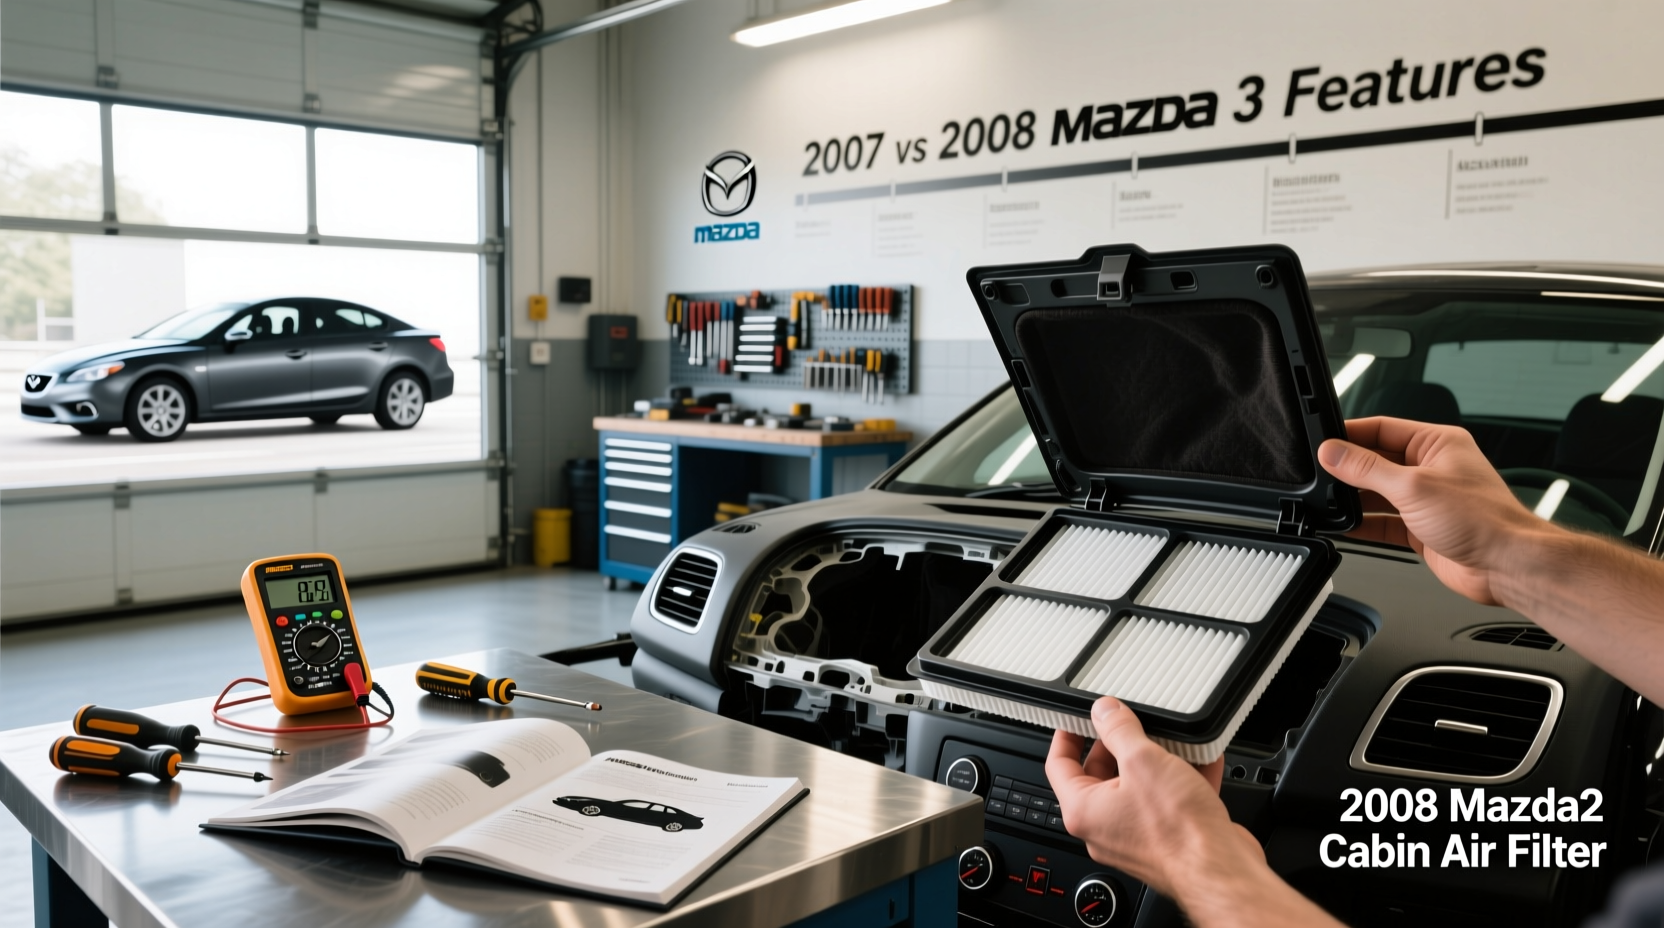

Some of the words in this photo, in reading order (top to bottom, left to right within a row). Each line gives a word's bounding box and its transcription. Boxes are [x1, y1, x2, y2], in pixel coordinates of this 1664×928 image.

[802, 132, 885, 177] 2007
[896, 137, 928, 164] vs
[938, 110, 1037, 160] 2008
[1233, 75, 1265, 123] 3
[1283, 47, 1547, 117] Features
